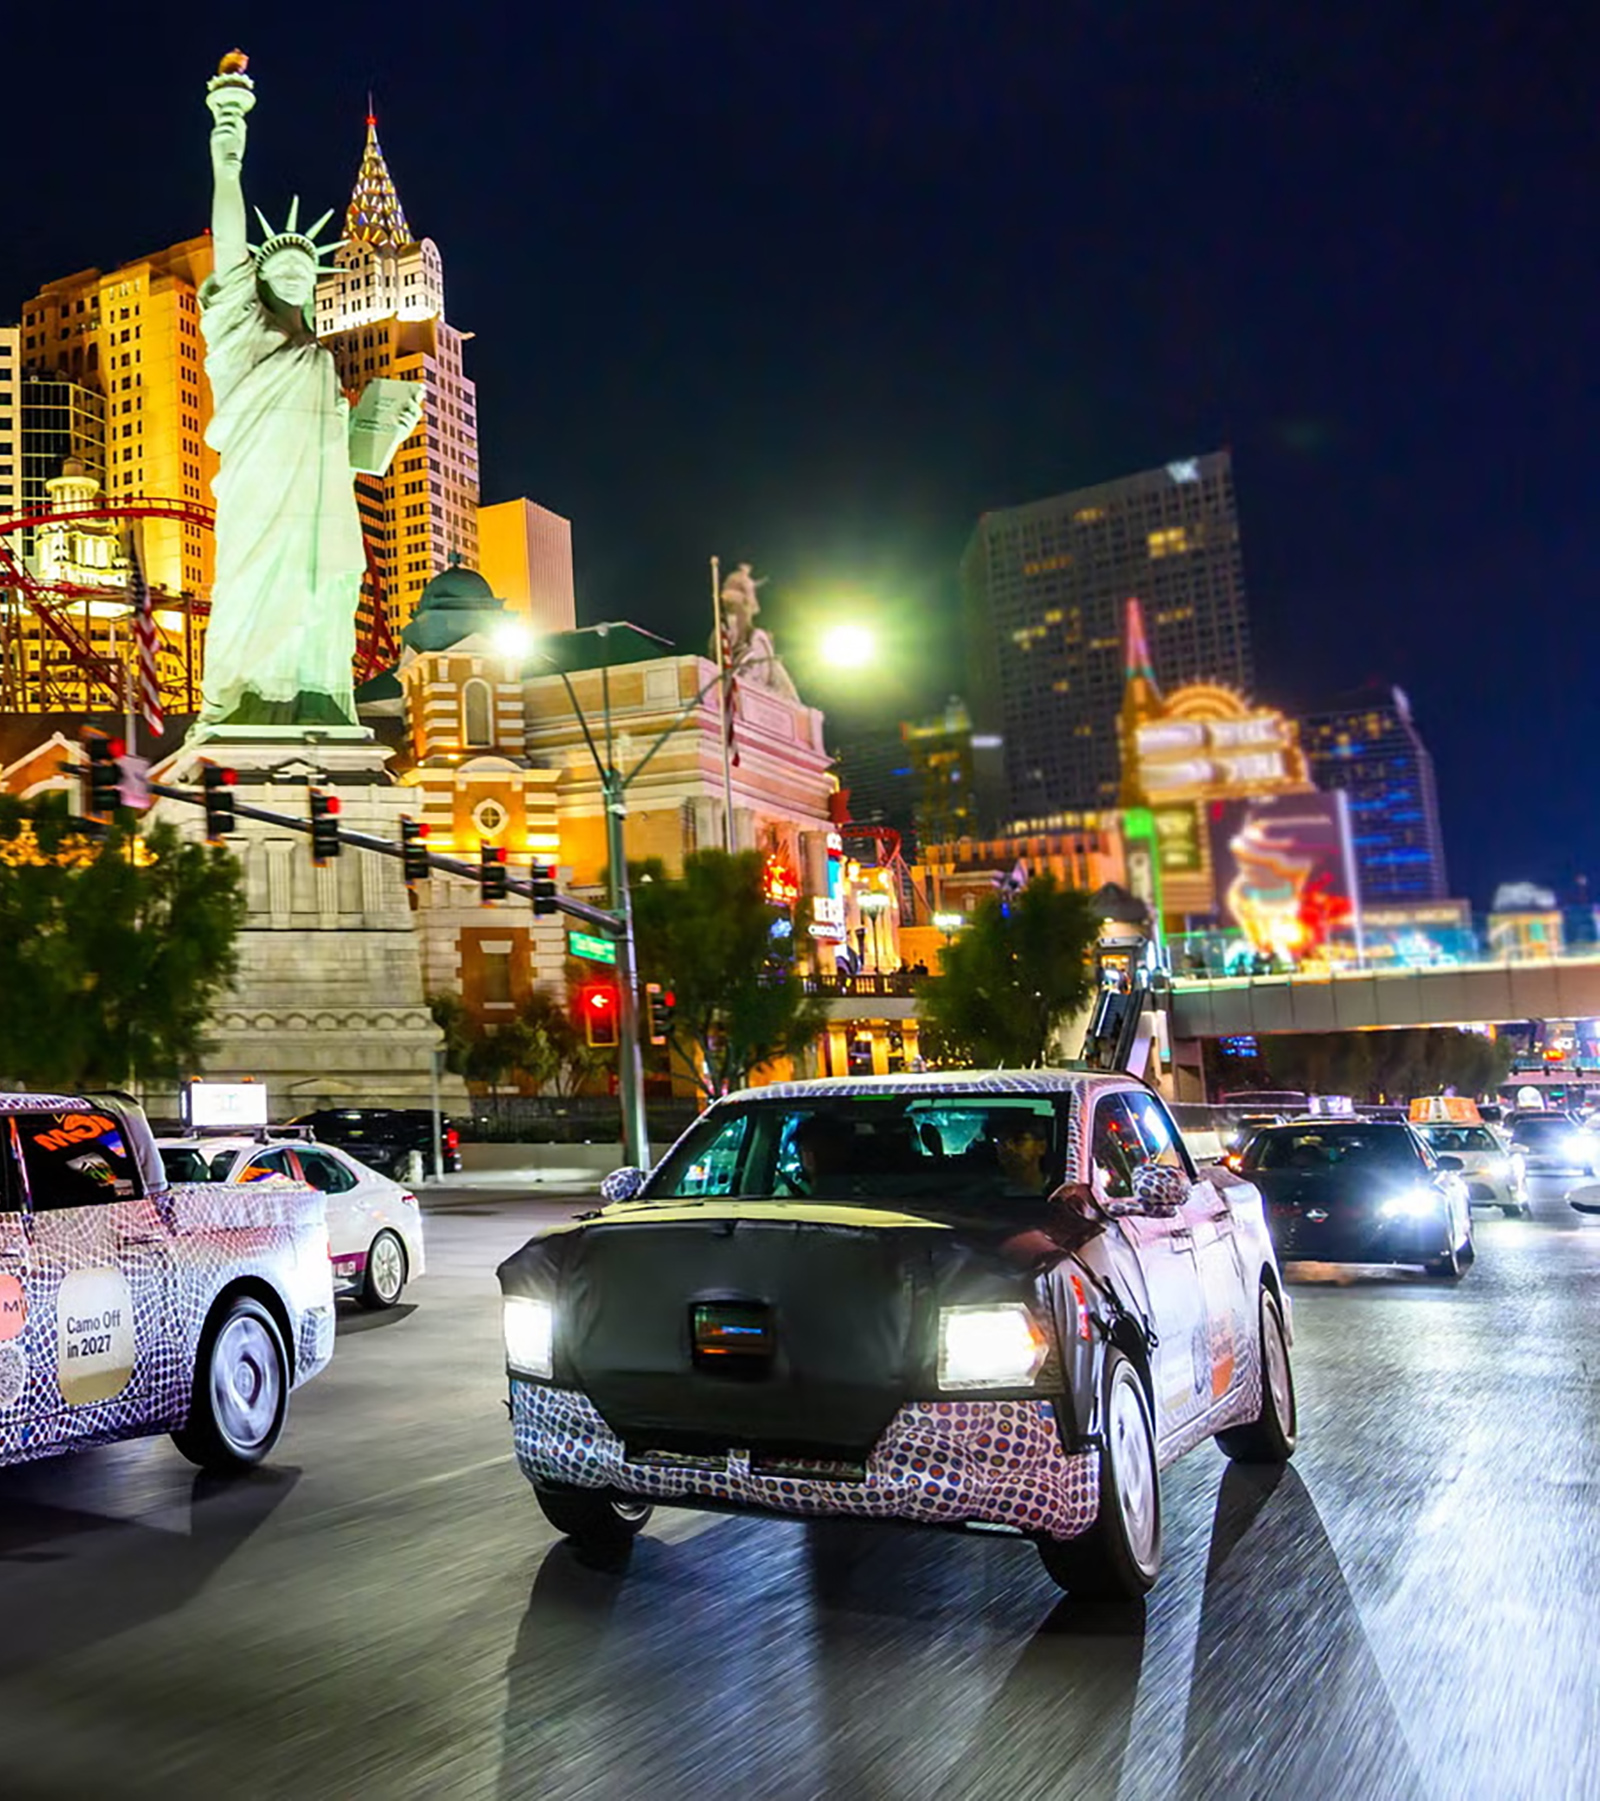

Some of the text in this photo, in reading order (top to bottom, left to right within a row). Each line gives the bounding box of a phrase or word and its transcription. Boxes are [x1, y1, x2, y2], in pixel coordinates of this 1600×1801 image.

[66, 1308, 121, 1335] Camo Off
[67, 1334, 111, 1359] in 2027
